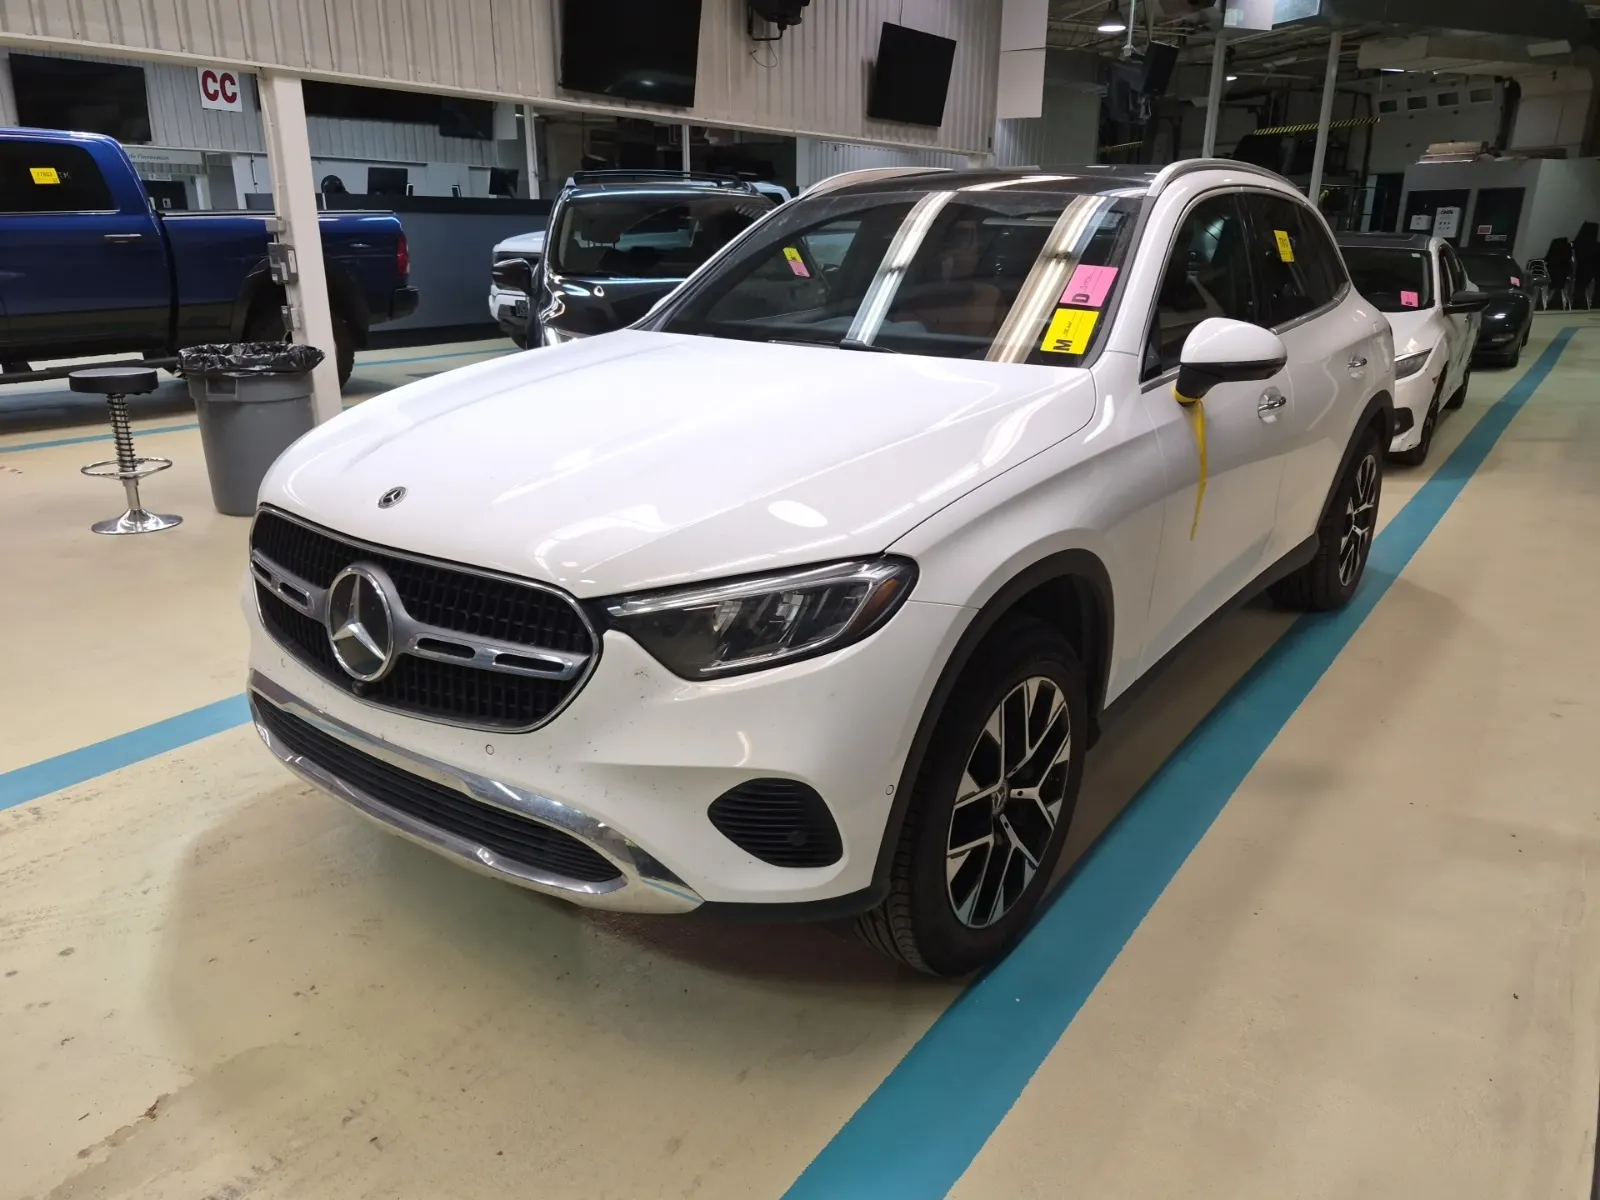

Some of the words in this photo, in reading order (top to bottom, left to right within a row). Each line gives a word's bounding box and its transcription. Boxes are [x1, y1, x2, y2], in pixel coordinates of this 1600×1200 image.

[202, 70, 237, 104] CC
[1072, 293, 1090, 303] D
[1053, 339, 1073, 351] M
